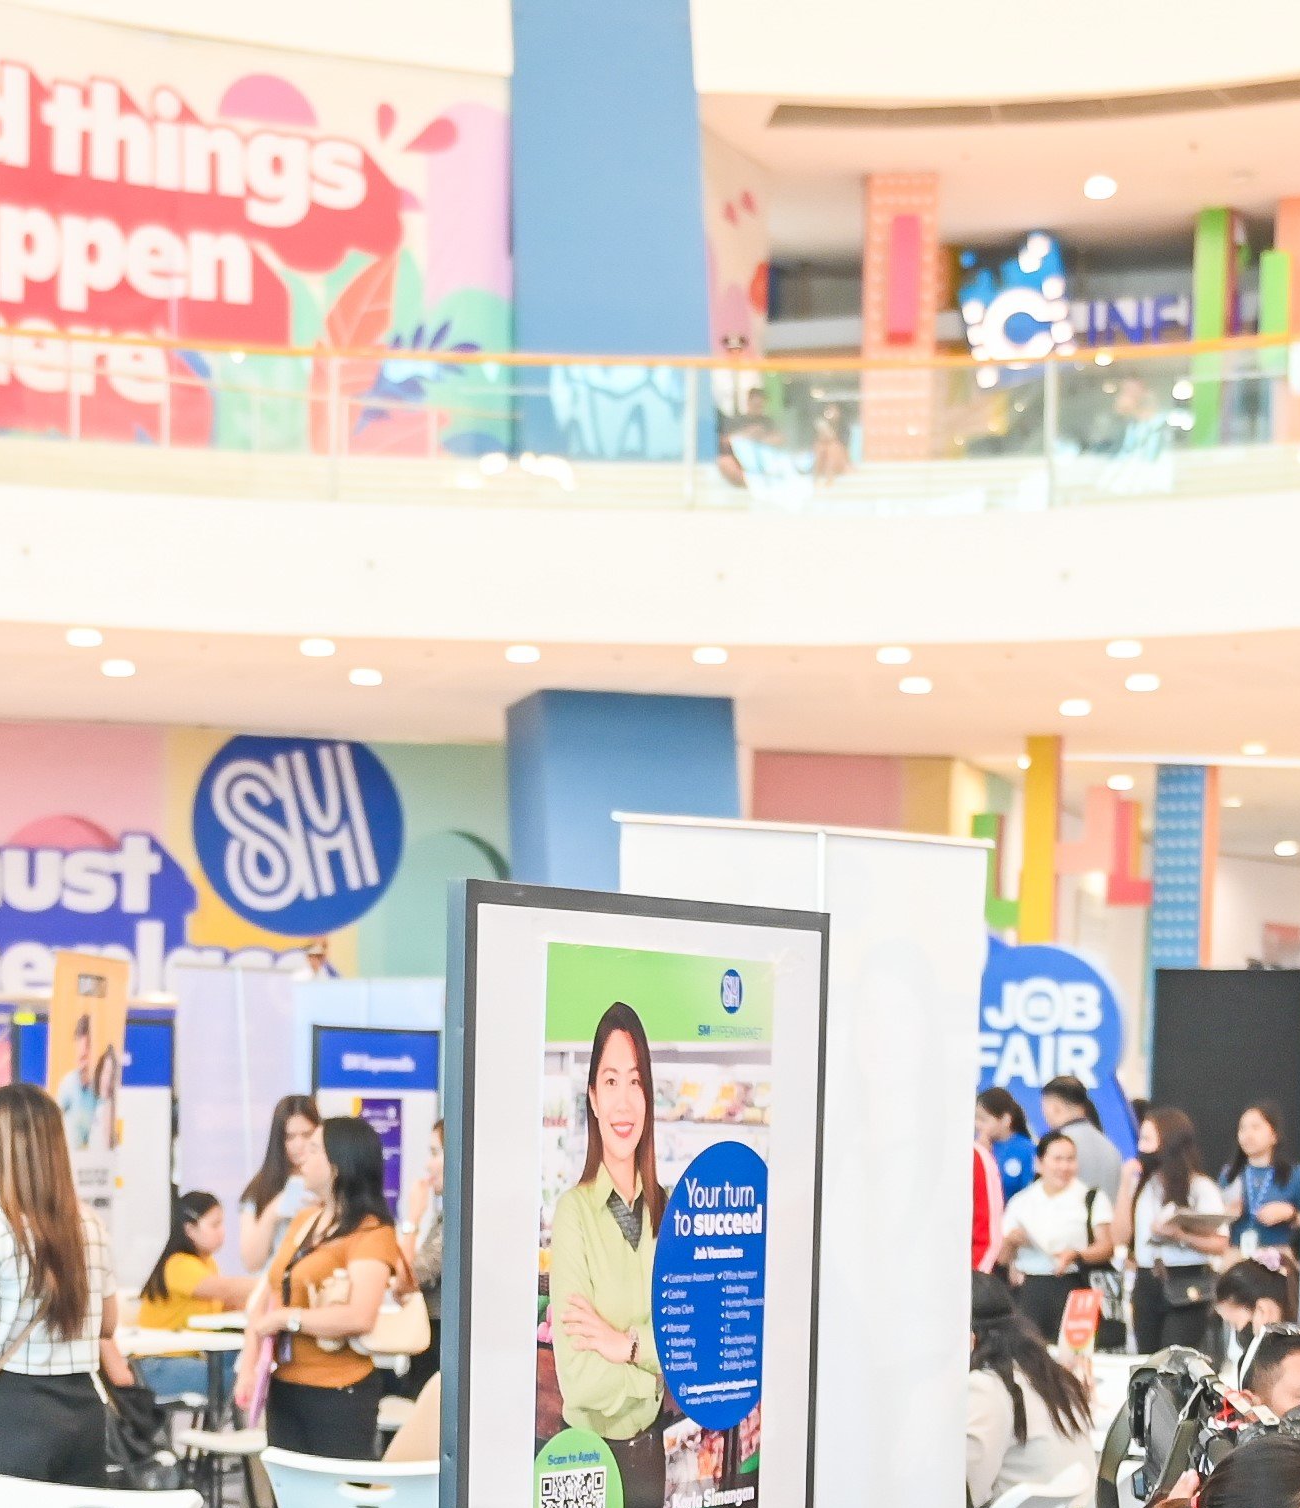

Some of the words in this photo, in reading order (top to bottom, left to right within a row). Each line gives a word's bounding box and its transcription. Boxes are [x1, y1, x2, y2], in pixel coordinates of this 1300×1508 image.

[42, 76, 367, 227] things
[212, 742, 382, 912] SM
[983, 977, 1103, 1034] JOB
[674, 1209, 691, 1236] to
[693, 1204, 762, 1236] succeed
[685, 1178, 721, 1208] Your
[724, 1181, 754, 1207] turn
